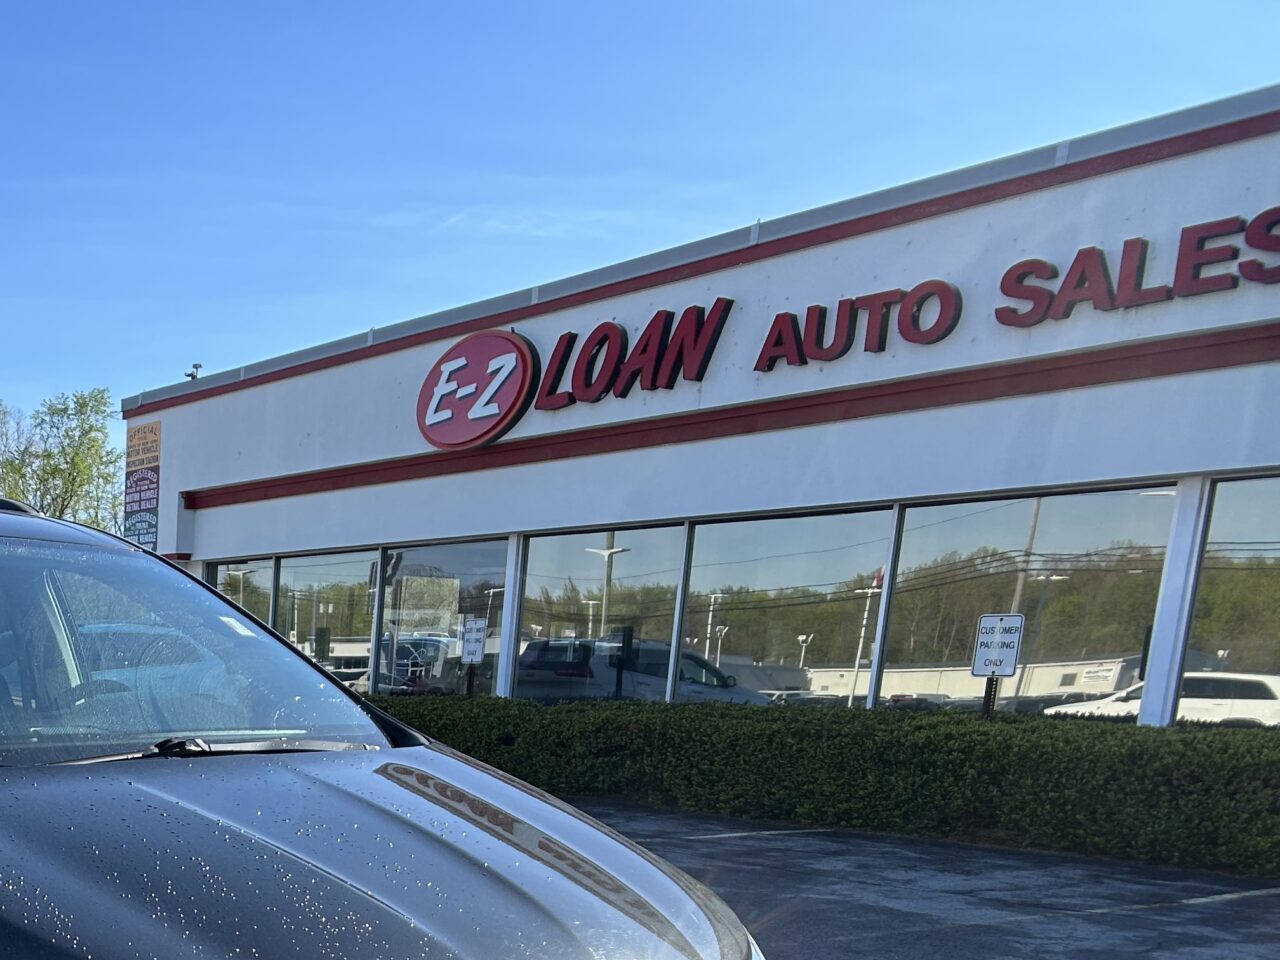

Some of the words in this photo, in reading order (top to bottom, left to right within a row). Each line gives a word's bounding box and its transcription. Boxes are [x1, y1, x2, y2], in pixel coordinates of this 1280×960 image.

[425, 352, 517, 426] E-Z
[534, 296, 735, 411] LOAN
[753, 279, 963, 372] AUTO
[128, 424, 158, 442] OFFICIAL
[126, 469, 158, 488] REGISTERED
[125, 512, 157, 529] REGISTERED
[980, 626, 1020, 635] CUSOMER
[979, 641, 1015, 649] PARING
[983, 658, 1004, 667] ONLY
